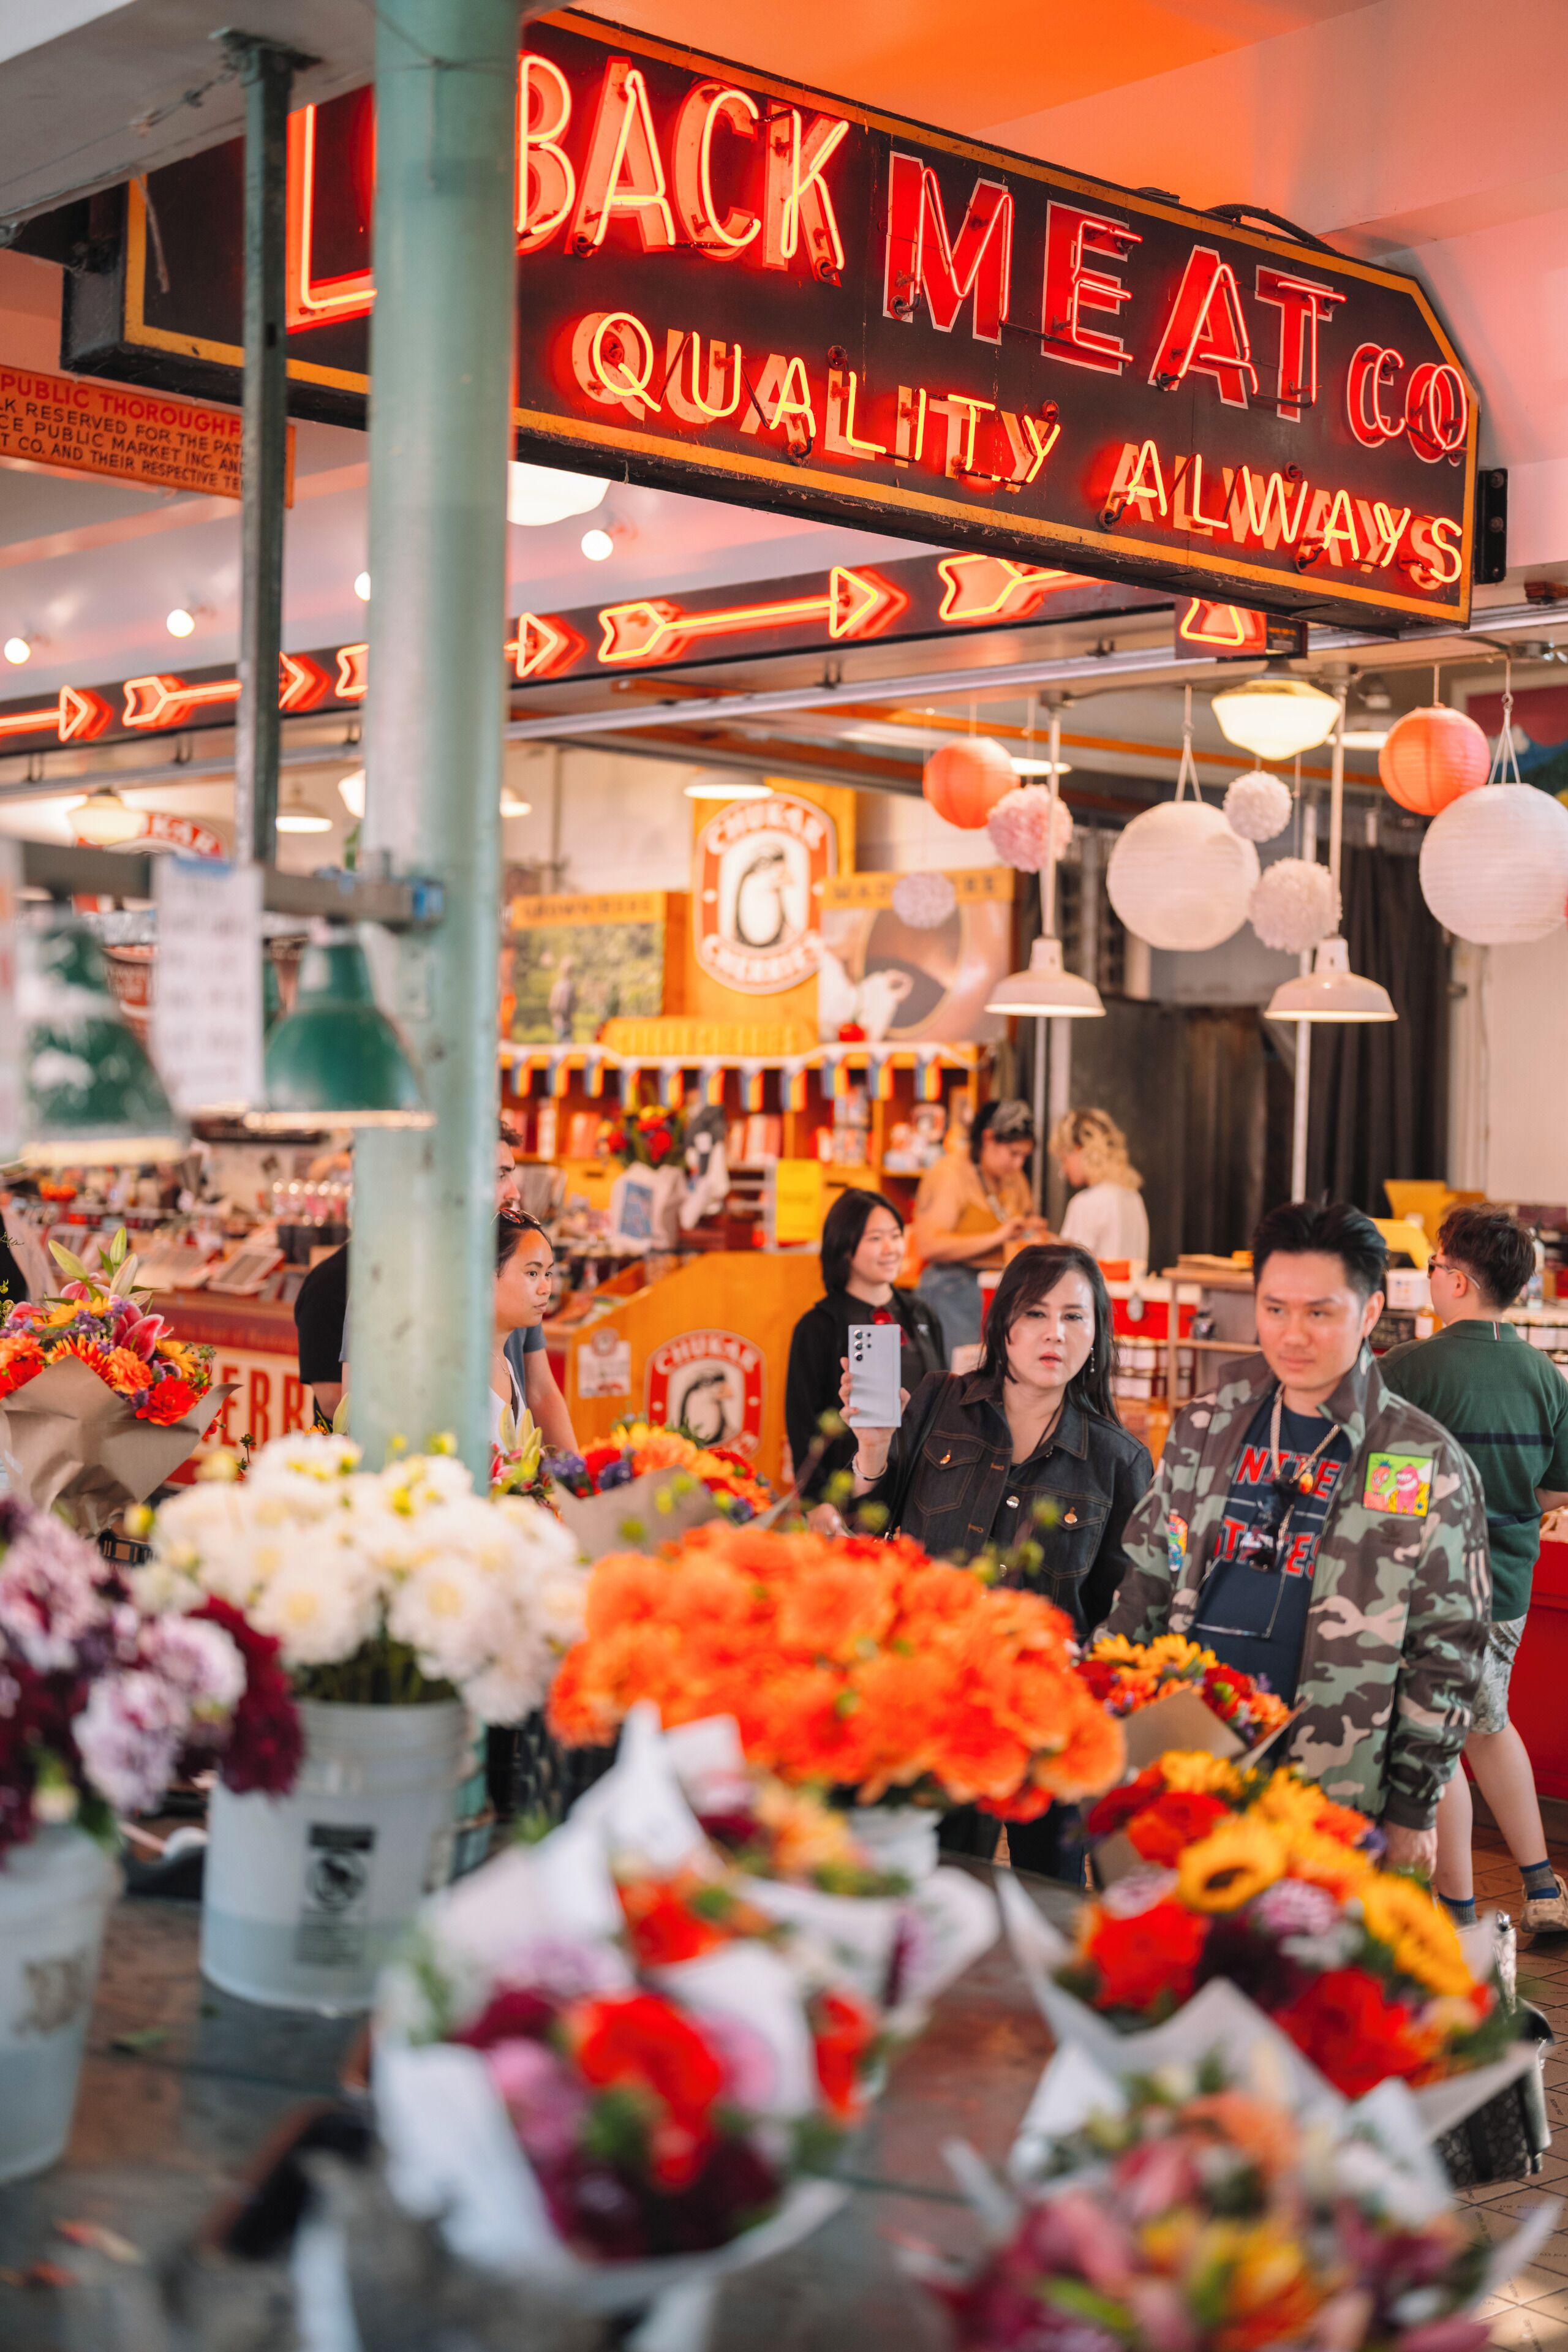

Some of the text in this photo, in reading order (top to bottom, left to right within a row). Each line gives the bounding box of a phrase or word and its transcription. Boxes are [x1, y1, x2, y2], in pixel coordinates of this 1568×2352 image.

[286, 50, 1468, 464] LBACK MEAT CO
[1, 373, 242, 437] PUBLIC THOROUGHF
[26, 402, 127, 434] RESERVED
[135, 423, 172, 443] FOR
[176, 431, 208, 451] THE
[214, 439, 243, 458] PAT
[18, 435, 45, 454] CO.
[51, 443, 83, 461] AND
[90, 450, 135, 471] THEIR
[141, 459, 217, 486] RESPECTIVE
[35, 421, 104, 448] PUBLIC
[111, 436, 181, 462] MARKET
[571, 312, 1462, 590] QUALITY ALWAYS
[655, 1336, 758, 1375] CHUKAR
